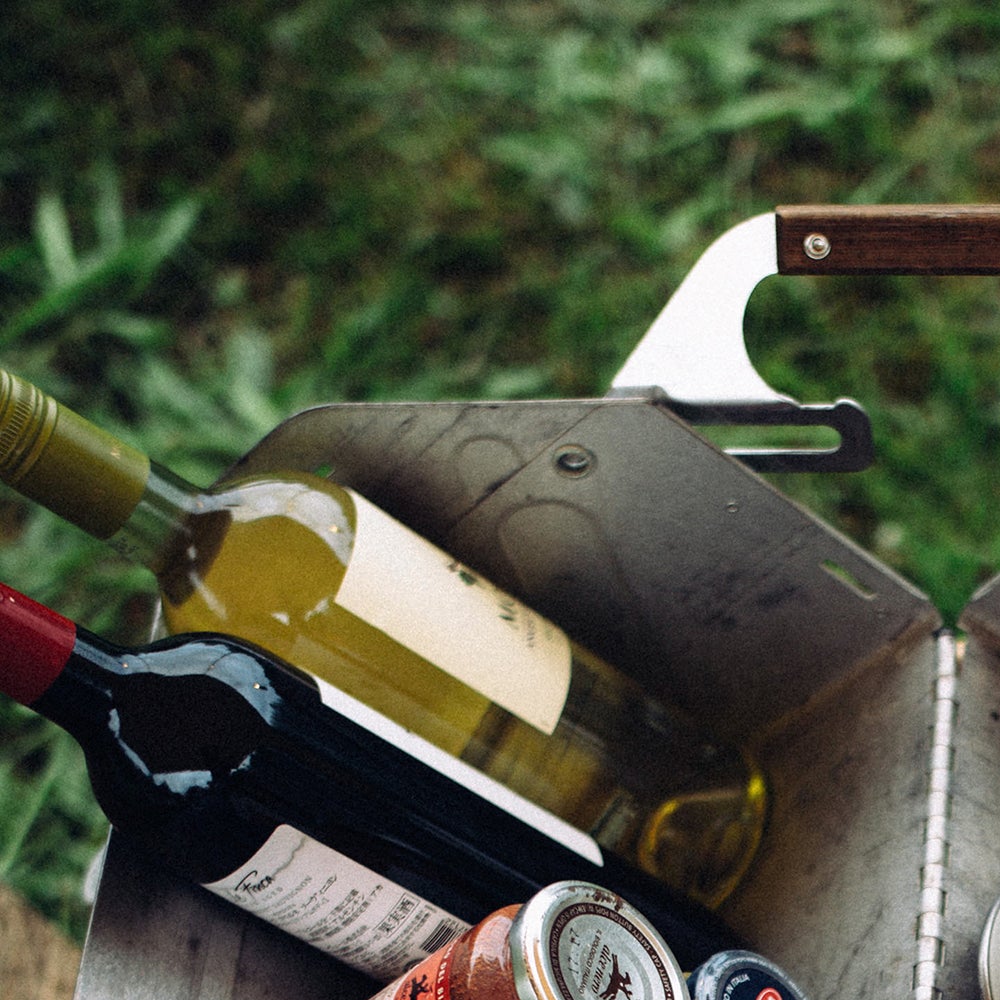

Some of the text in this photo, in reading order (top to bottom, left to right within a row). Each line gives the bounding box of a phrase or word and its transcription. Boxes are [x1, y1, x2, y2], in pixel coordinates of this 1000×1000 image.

[377, 896, 414, 933] 果実酒
[609, 910, 632, 930] BUTTON
[632, 927, 651, 950] SAFETY
[585, 935, 602, 967] BIOLOGICO
[651, 953, 662, 967] CAP
[438, 962, 446, 983] DEL
[578, 966, 590, 994] ITALIANO
[590, 944, 611, 994] alce nero
[658, 968, 671, 992] SAFETY
[725, 986, 734, 994] IN
[731, 973, 751, 991] ITALIA
